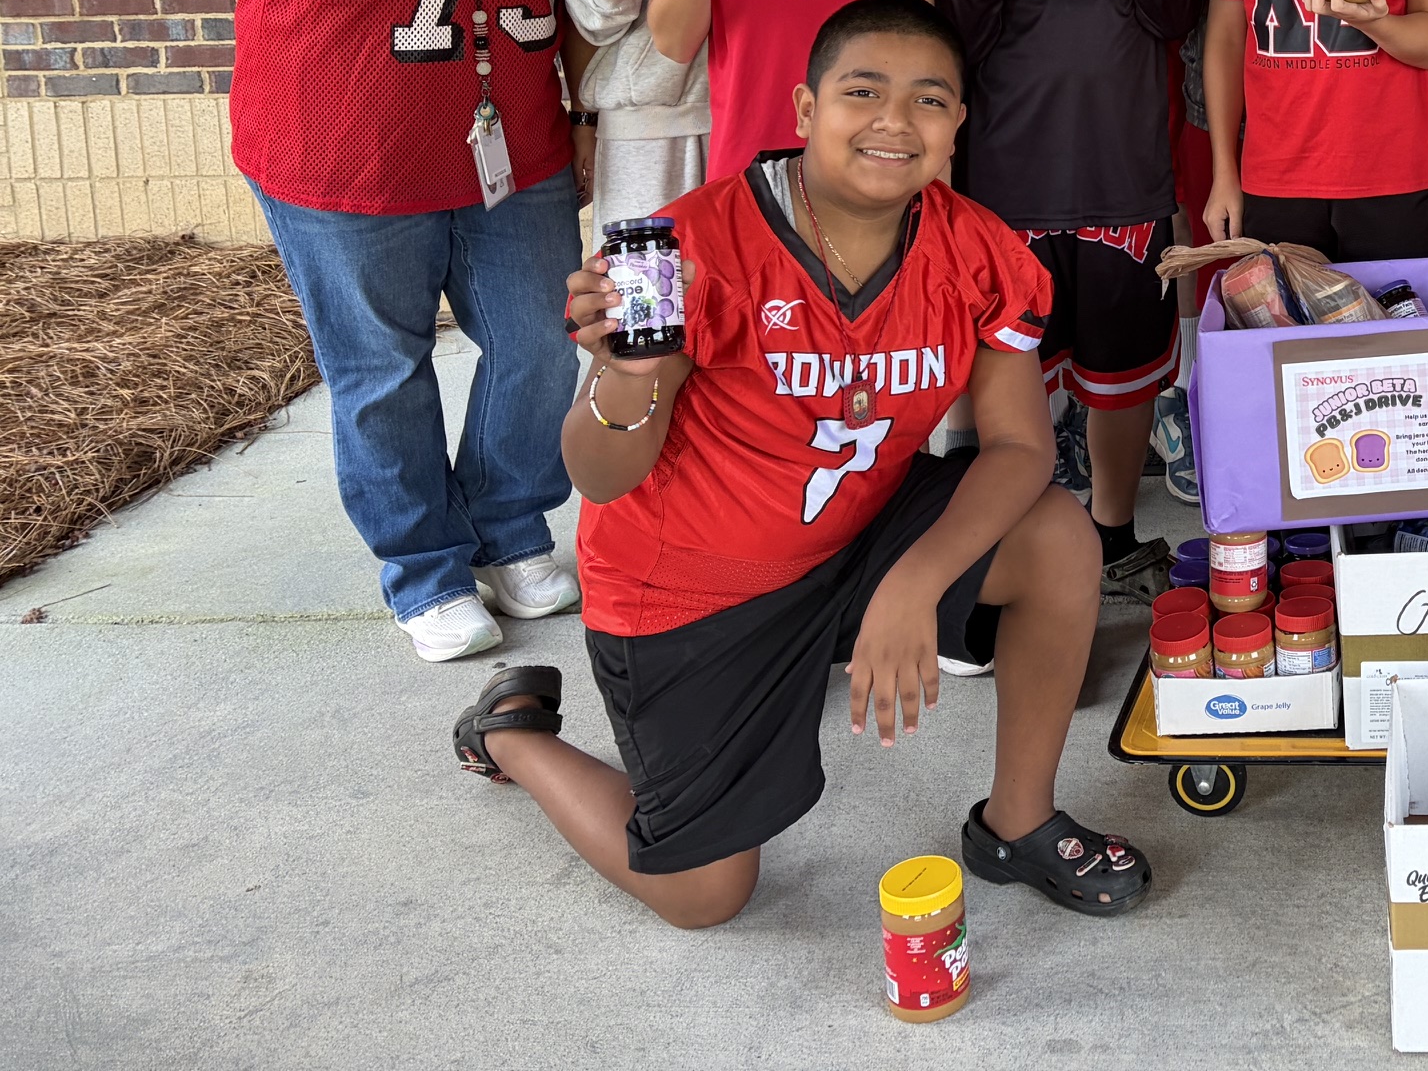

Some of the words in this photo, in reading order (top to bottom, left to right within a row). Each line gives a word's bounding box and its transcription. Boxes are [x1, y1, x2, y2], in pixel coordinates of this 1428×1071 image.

[1285, 59, 1331, 70] MIDDLE
[1335, 55, 1380, 69] SCHOOL
[764, 344, 946, 398] BOWDON
[1312, 382, 1371, 423] JUNIOR
[1369, 378, 1418, 395] BETA
[1315, 401, 1363, 439] PB&J
[1363, 393, 1423, 412] DRIVE
[801, 417, 895, 526] 7
[1210, 700, 1240, 710] Great
[1251, 703, 1274, 711] Grape
[1274, 702, 1292, 710] Jelly
